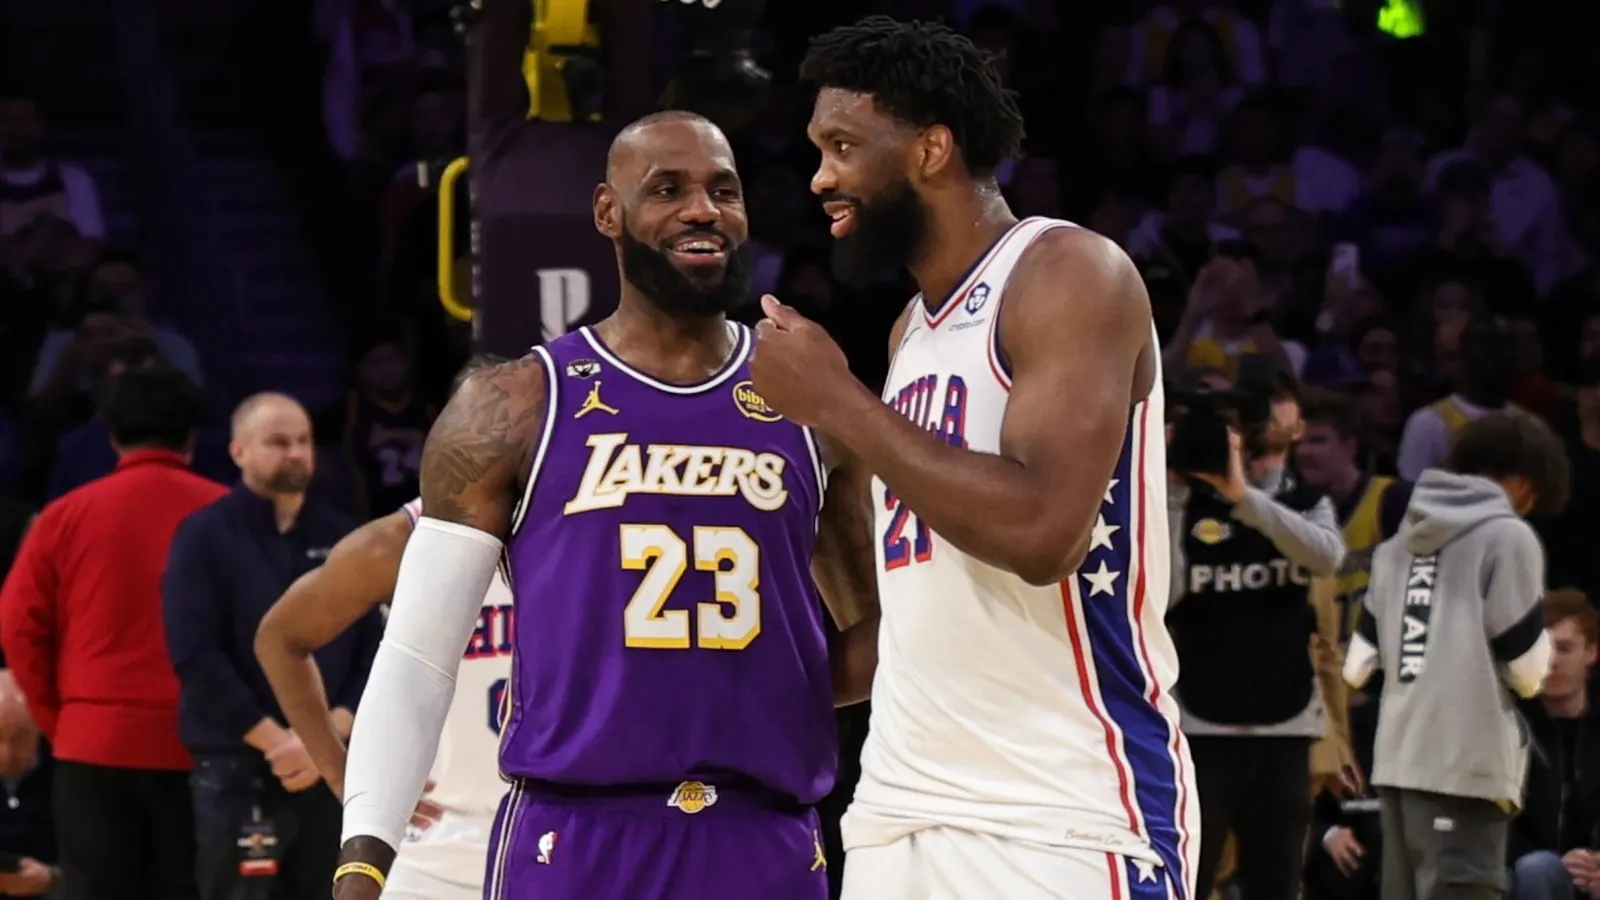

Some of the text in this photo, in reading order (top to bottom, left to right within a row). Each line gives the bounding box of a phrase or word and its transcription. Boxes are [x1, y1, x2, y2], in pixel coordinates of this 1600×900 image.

[887, 374, 969, 450] ILA
[563, 433, 788, 516] LAKERS
[619, 523, 762, 650] 23
[1400, 556, 1437, 676] IKE AIR
